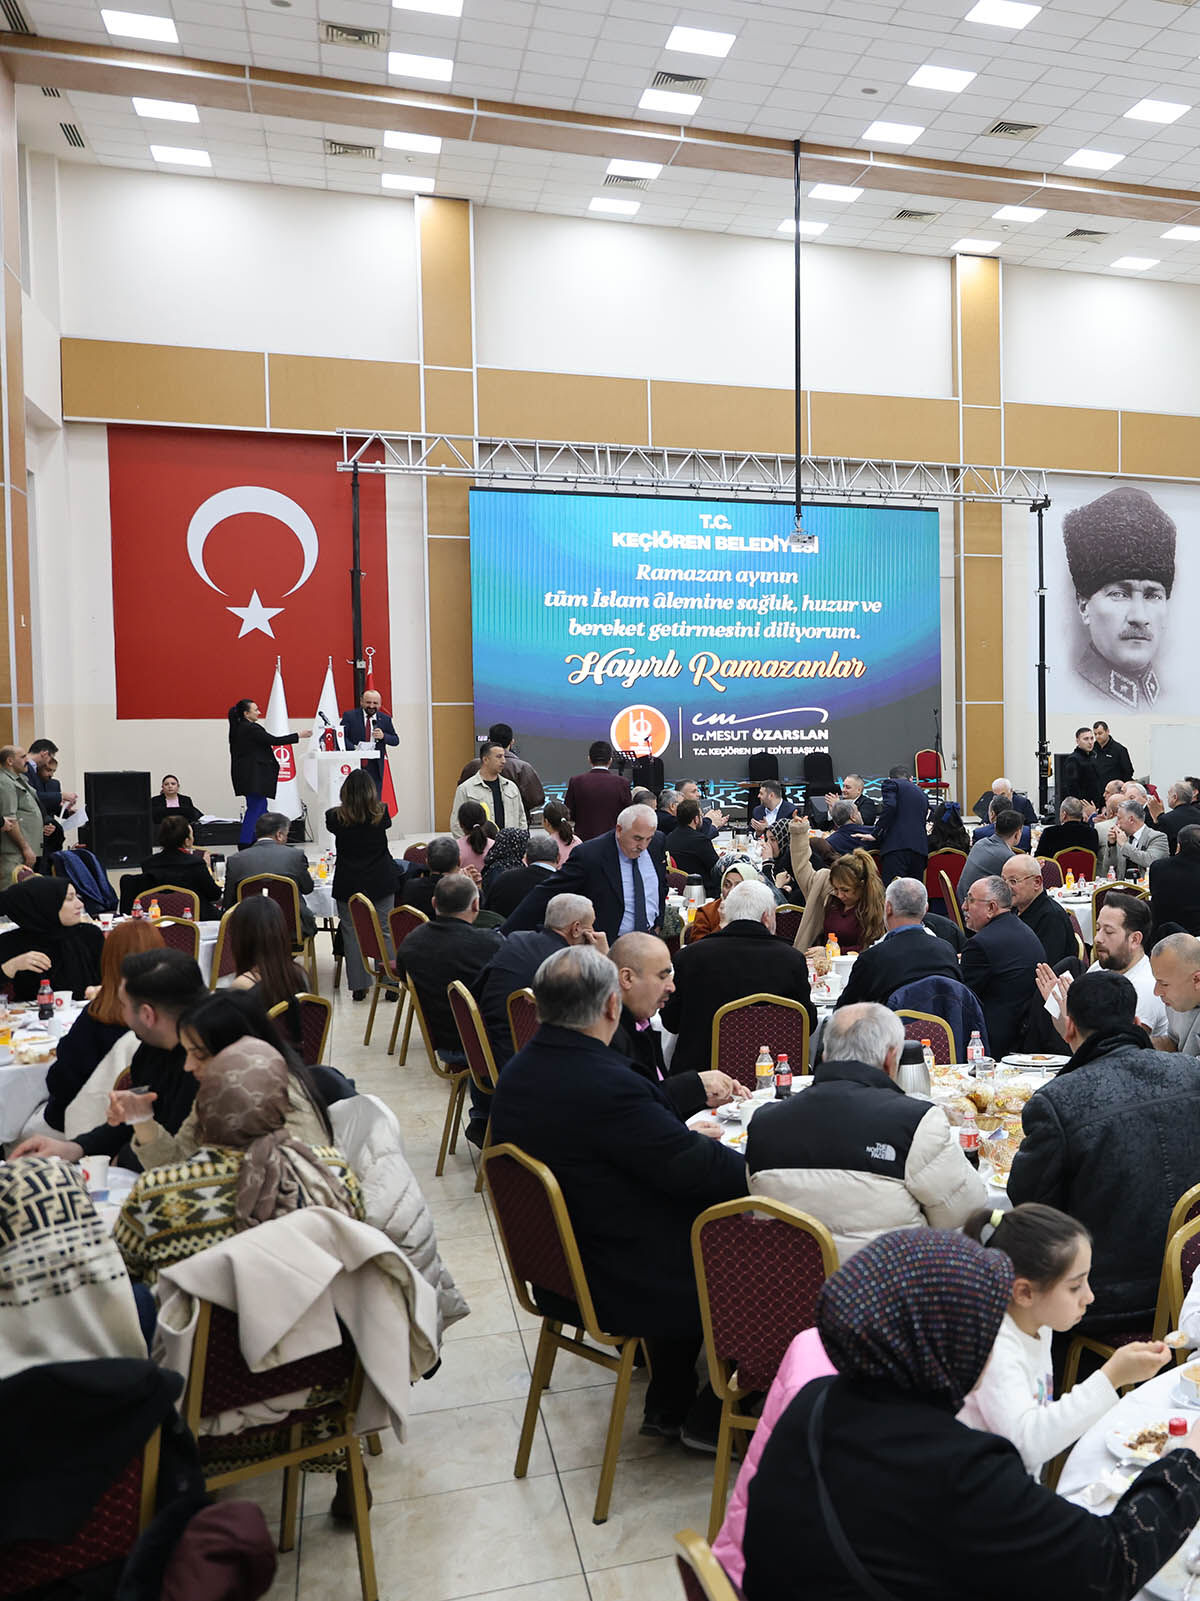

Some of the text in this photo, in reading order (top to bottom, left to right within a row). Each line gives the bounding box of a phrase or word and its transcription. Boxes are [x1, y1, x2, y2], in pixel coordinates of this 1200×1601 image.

[699, 514, 733, 530] T.C.
[612, 530, 711, 552] KEÇİÖREN
[636, 564, 799, 587] Ramazan ayının
[544, 588, 882, 615] tüm İslam âlemine sağlık, huzur ve
[568, 618, 861, 643] bereket getirmesini diliyorum.
[564, 647, 867, 693] Hayırlı Ramazanlar
[752, 728, 829, 741] ÖZARSLAN
[692, 748, 708, 756] T.C.
[708, 746, 751, 757] KEÇİÖREN
